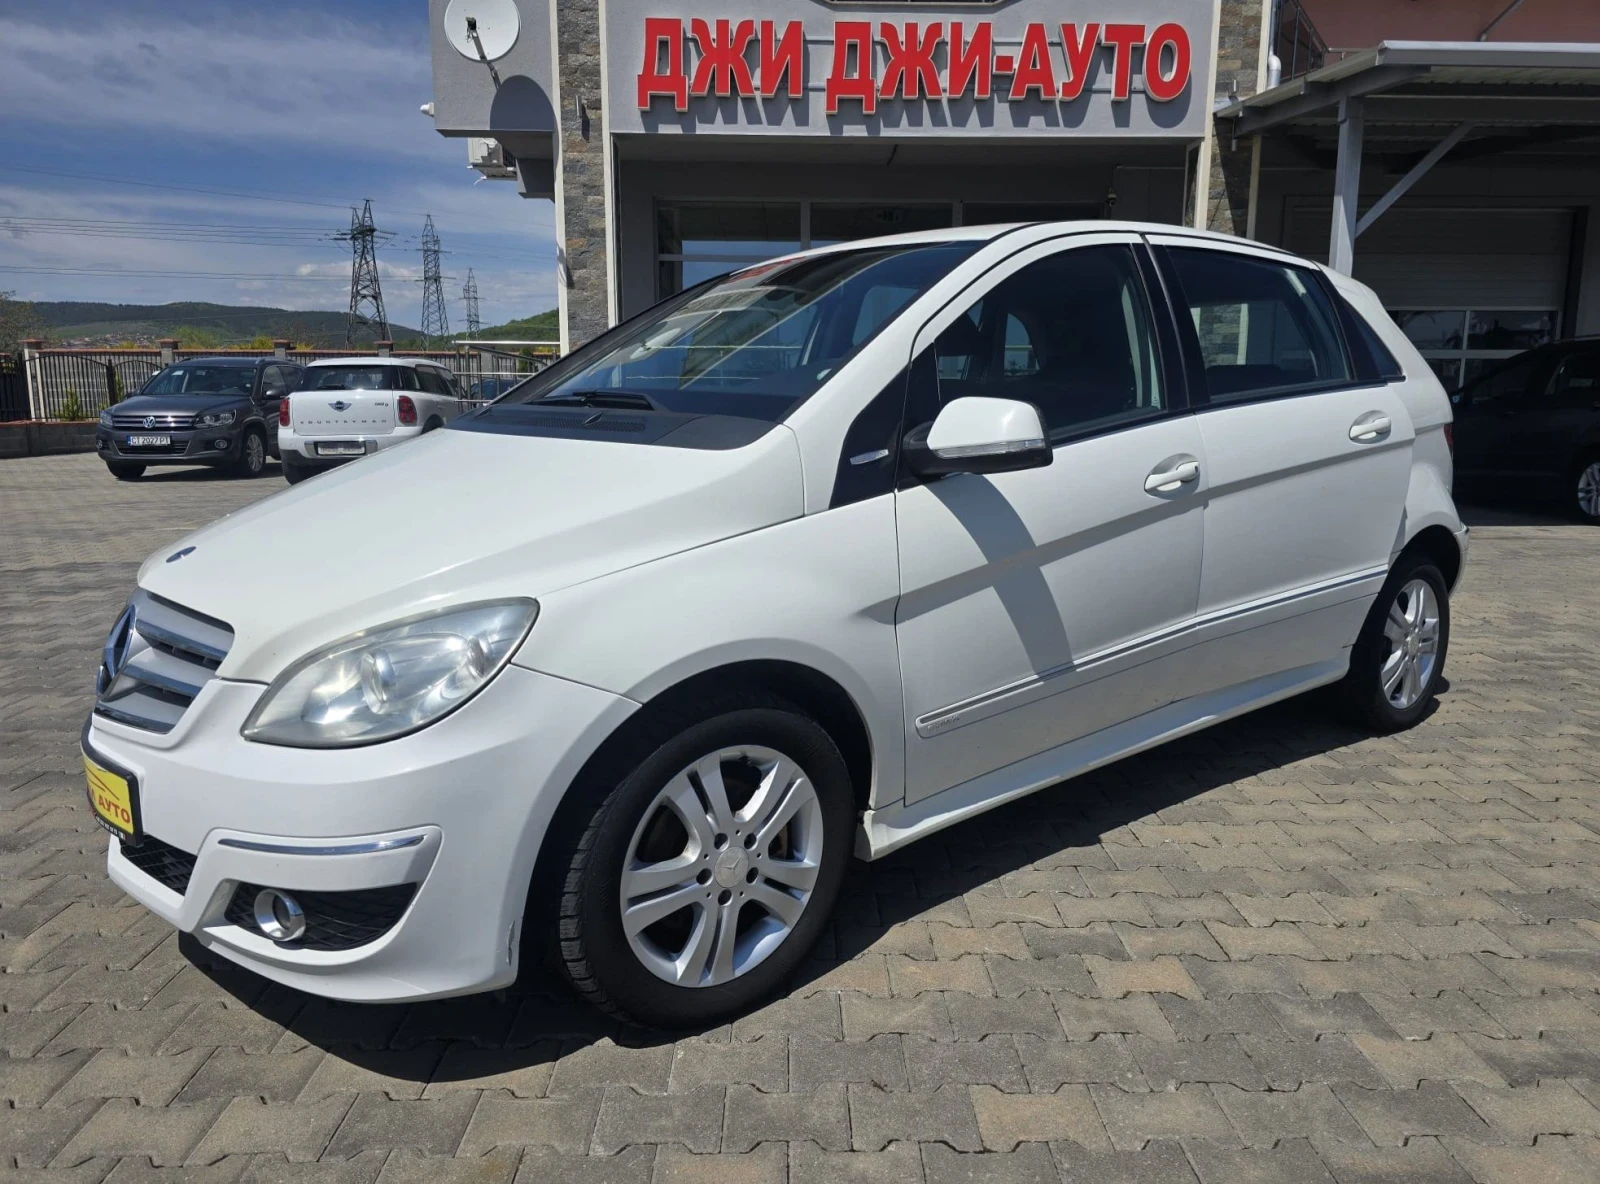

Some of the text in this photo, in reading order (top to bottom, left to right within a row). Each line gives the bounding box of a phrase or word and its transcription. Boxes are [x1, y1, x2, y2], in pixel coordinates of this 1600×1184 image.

[637, 18, 1192, 116] ДЖИ ДЖИ-АУТО
[98, 794, 131, 824] АУТО
